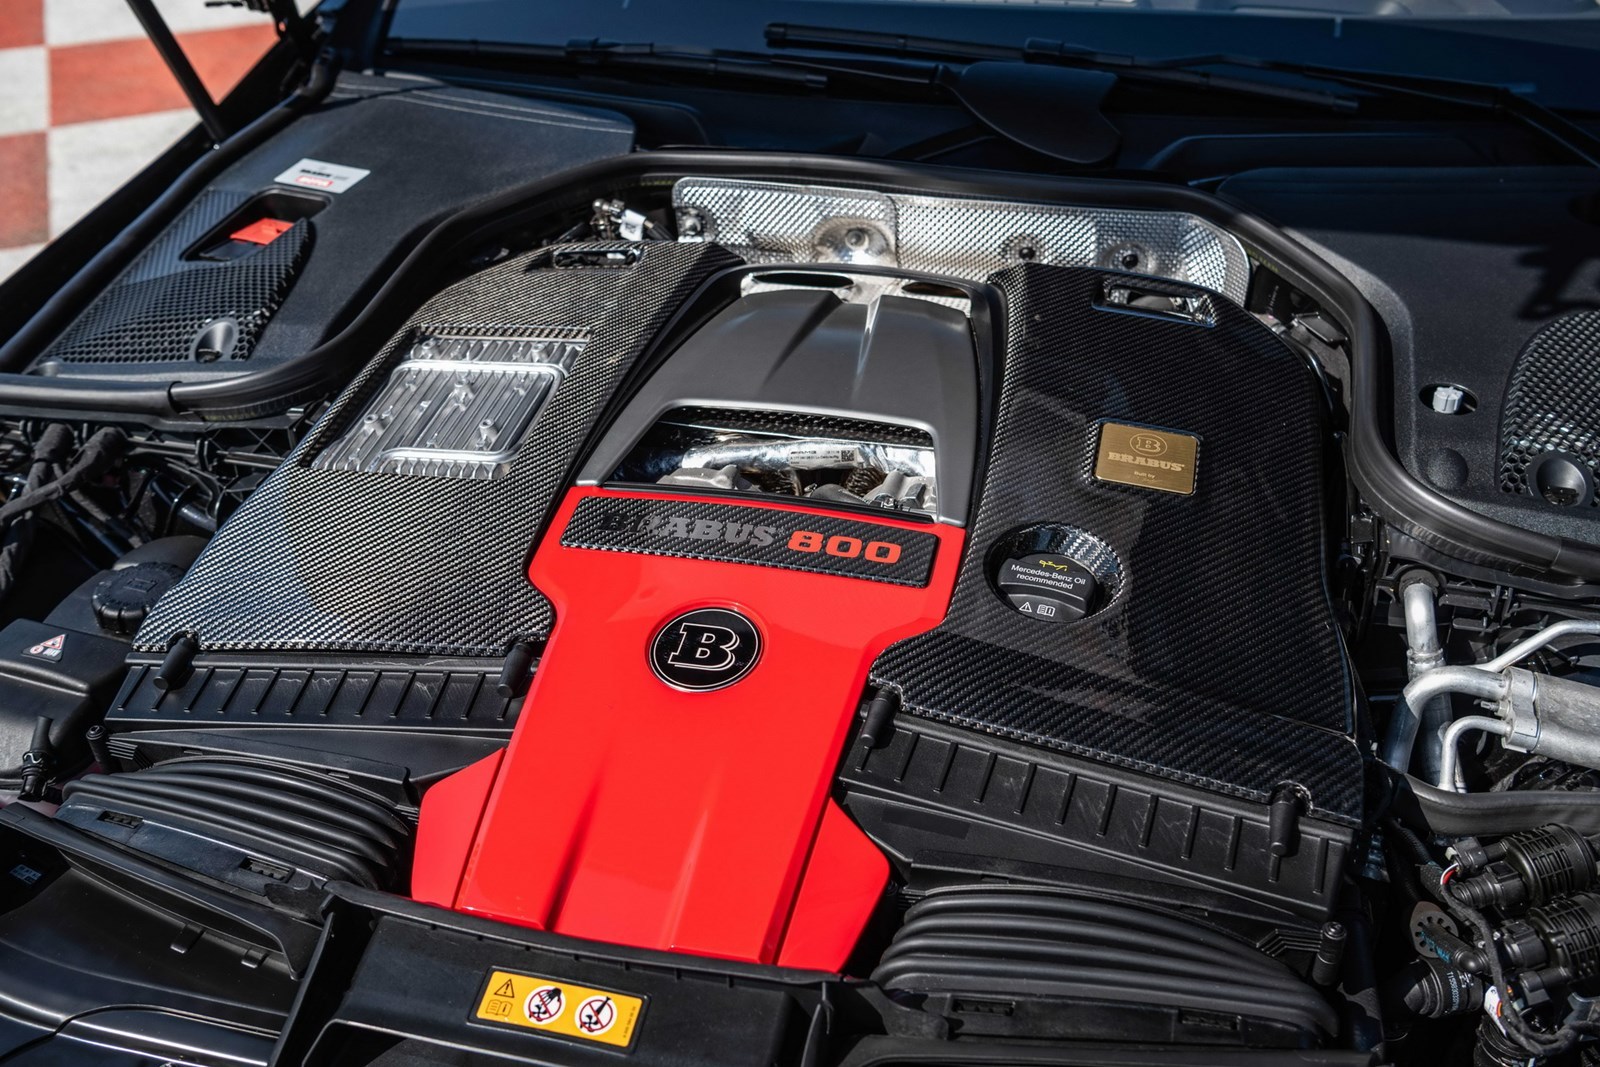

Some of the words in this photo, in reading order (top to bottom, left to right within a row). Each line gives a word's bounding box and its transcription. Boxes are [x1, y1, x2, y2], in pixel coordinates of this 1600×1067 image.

[1107, 451, 1184, 472] BRABUS
[597, 511, 777, 548] BRABUS
[786, 530, 902, 564] 800
[1011, 564, 1072, 583] Mercedes-Benz
[1074, 577, 1086, 585] Oil
[1016, 573, 1073, 589] recommended
[668, 622, 740, 671] B
